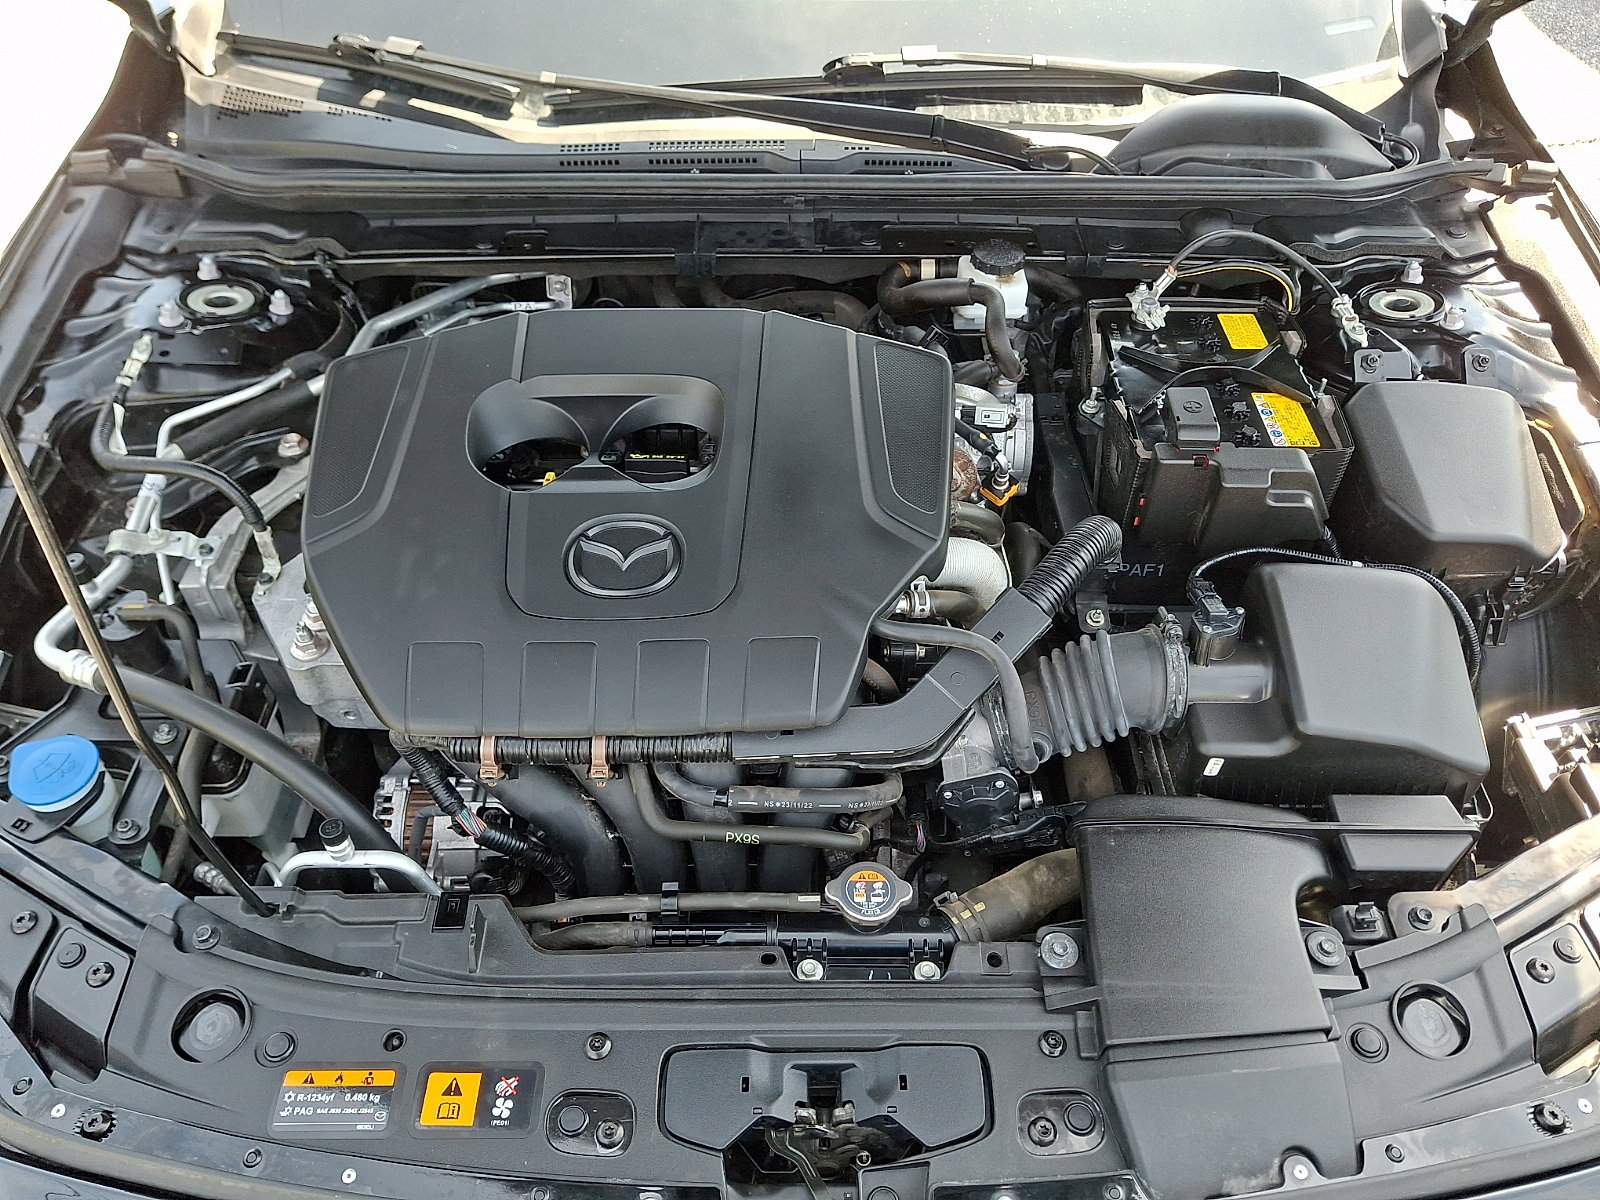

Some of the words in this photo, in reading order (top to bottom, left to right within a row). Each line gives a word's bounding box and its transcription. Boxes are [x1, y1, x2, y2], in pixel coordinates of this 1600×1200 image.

[725, 831, 760, 845] PX9S
[296, 1093, 335, 1104] R-1234yf
[344, 1093, 368, 1102] 0.480
[368, 1093, 381, 1103] kg
[293, 1107, 314, 1115] PAG
